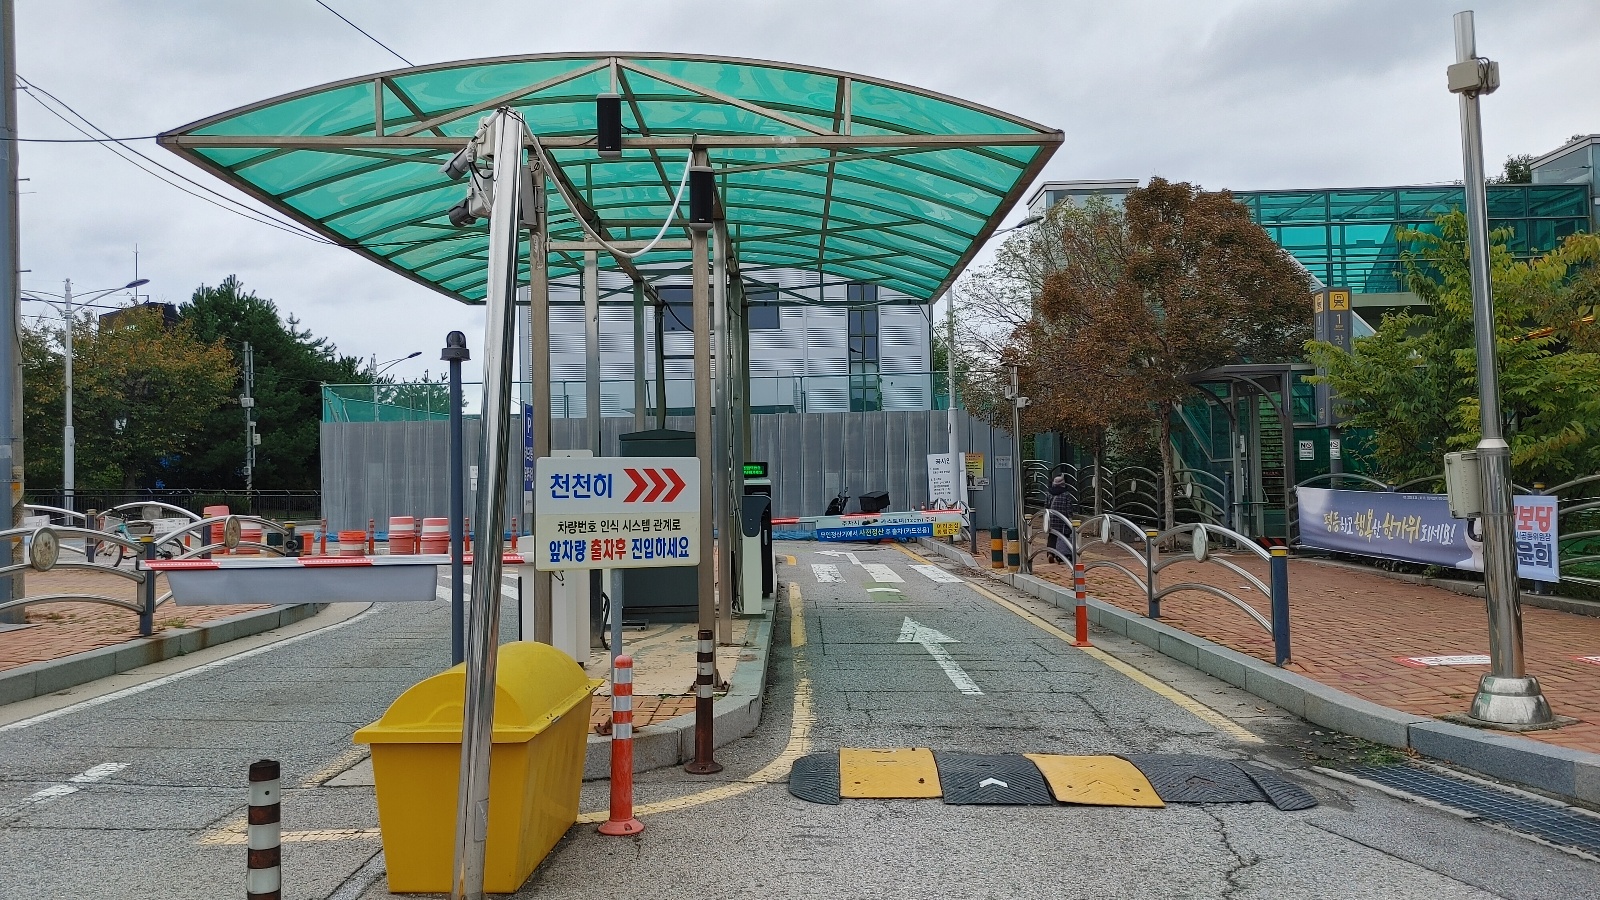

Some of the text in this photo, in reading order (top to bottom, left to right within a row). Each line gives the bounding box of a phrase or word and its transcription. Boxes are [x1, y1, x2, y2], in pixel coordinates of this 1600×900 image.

[1336, 313, 1341, 324] 1
[550, 473, 613, 498] 천천히
[557, 518, 681, 534] 차량번호 인식 시스템 관계로
[859, 528, 885, 537] 사전정산
[1323, 508, 1457, 546] 평등하고 행복한 한가위 되세요!
[550, 536, 690, 563] 앞차량 출차후 진입하세요
